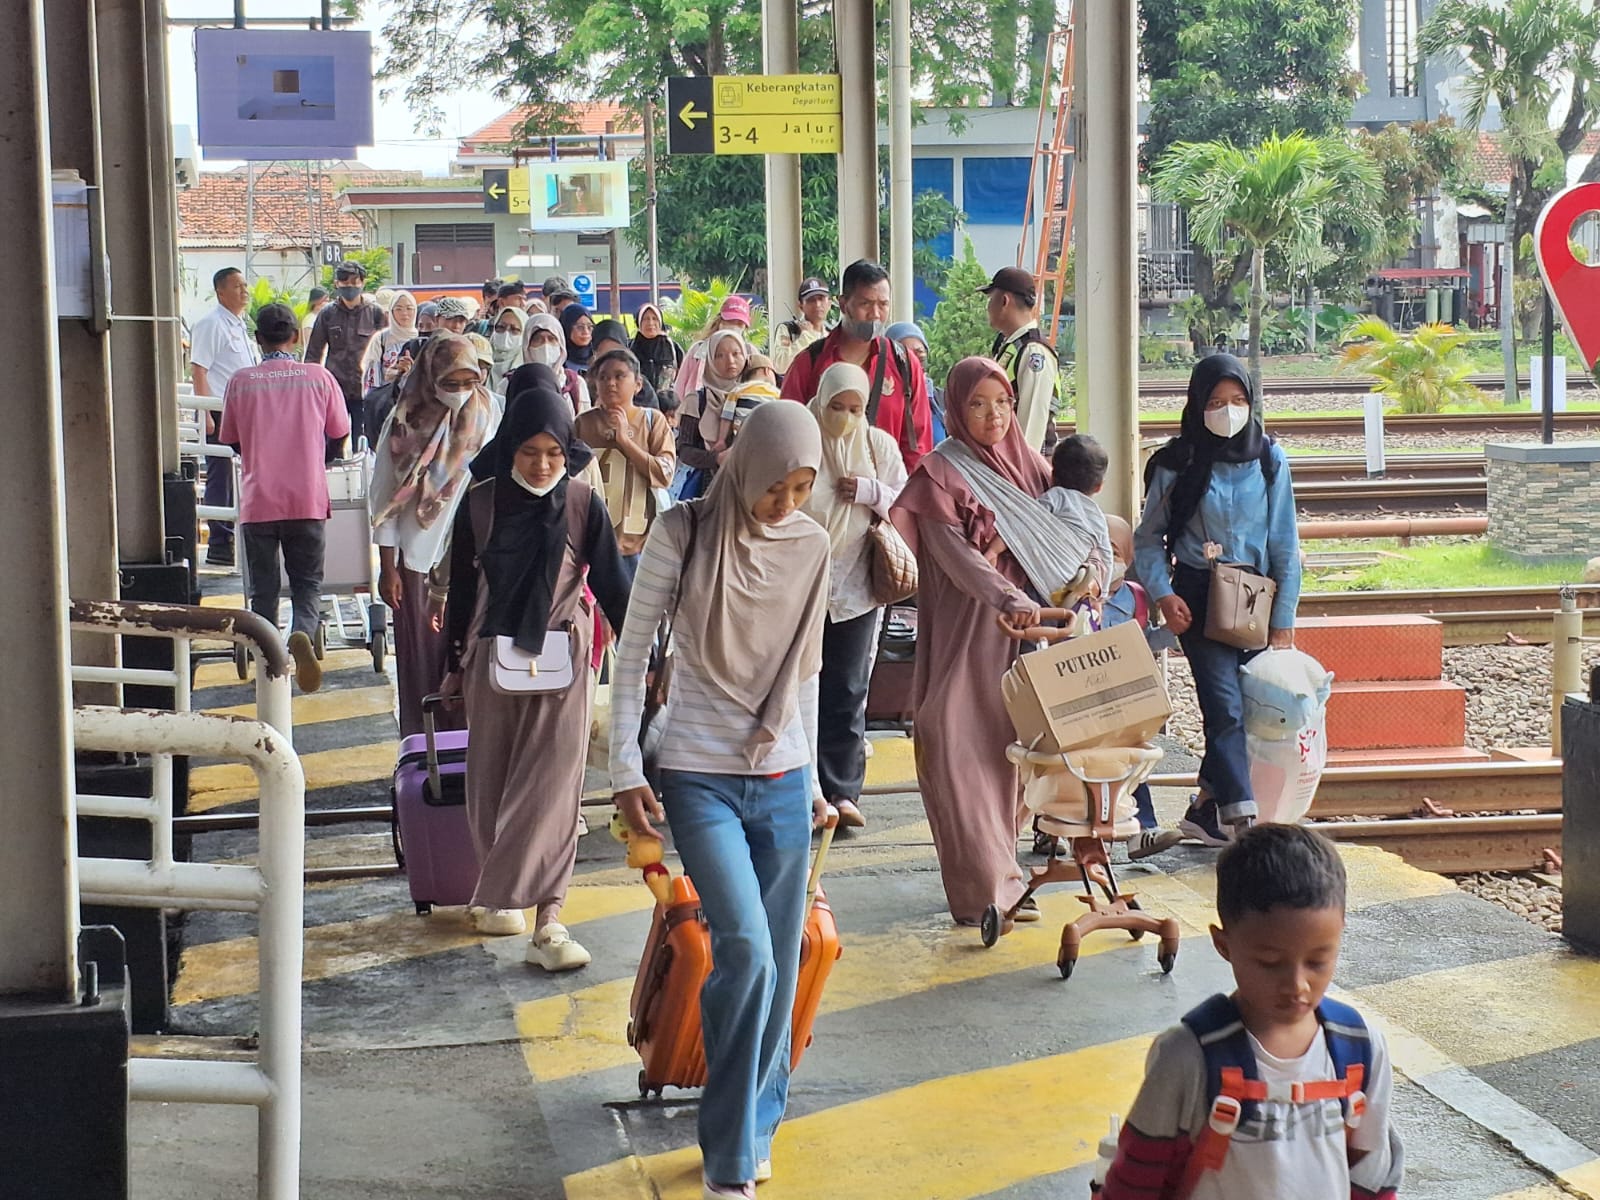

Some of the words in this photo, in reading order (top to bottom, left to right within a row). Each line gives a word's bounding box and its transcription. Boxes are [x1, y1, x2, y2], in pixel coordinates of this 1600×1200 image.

[747, 82, 835, 94] Keberangkatan
[792, 97, 834, 106] Departure
[719, 126, 759, 144] 3-4
[782, 121, 835, 134] Jalur
[512, 196, 531, 208] 5-
[1055, 644, 1122, 678] PUTROE
